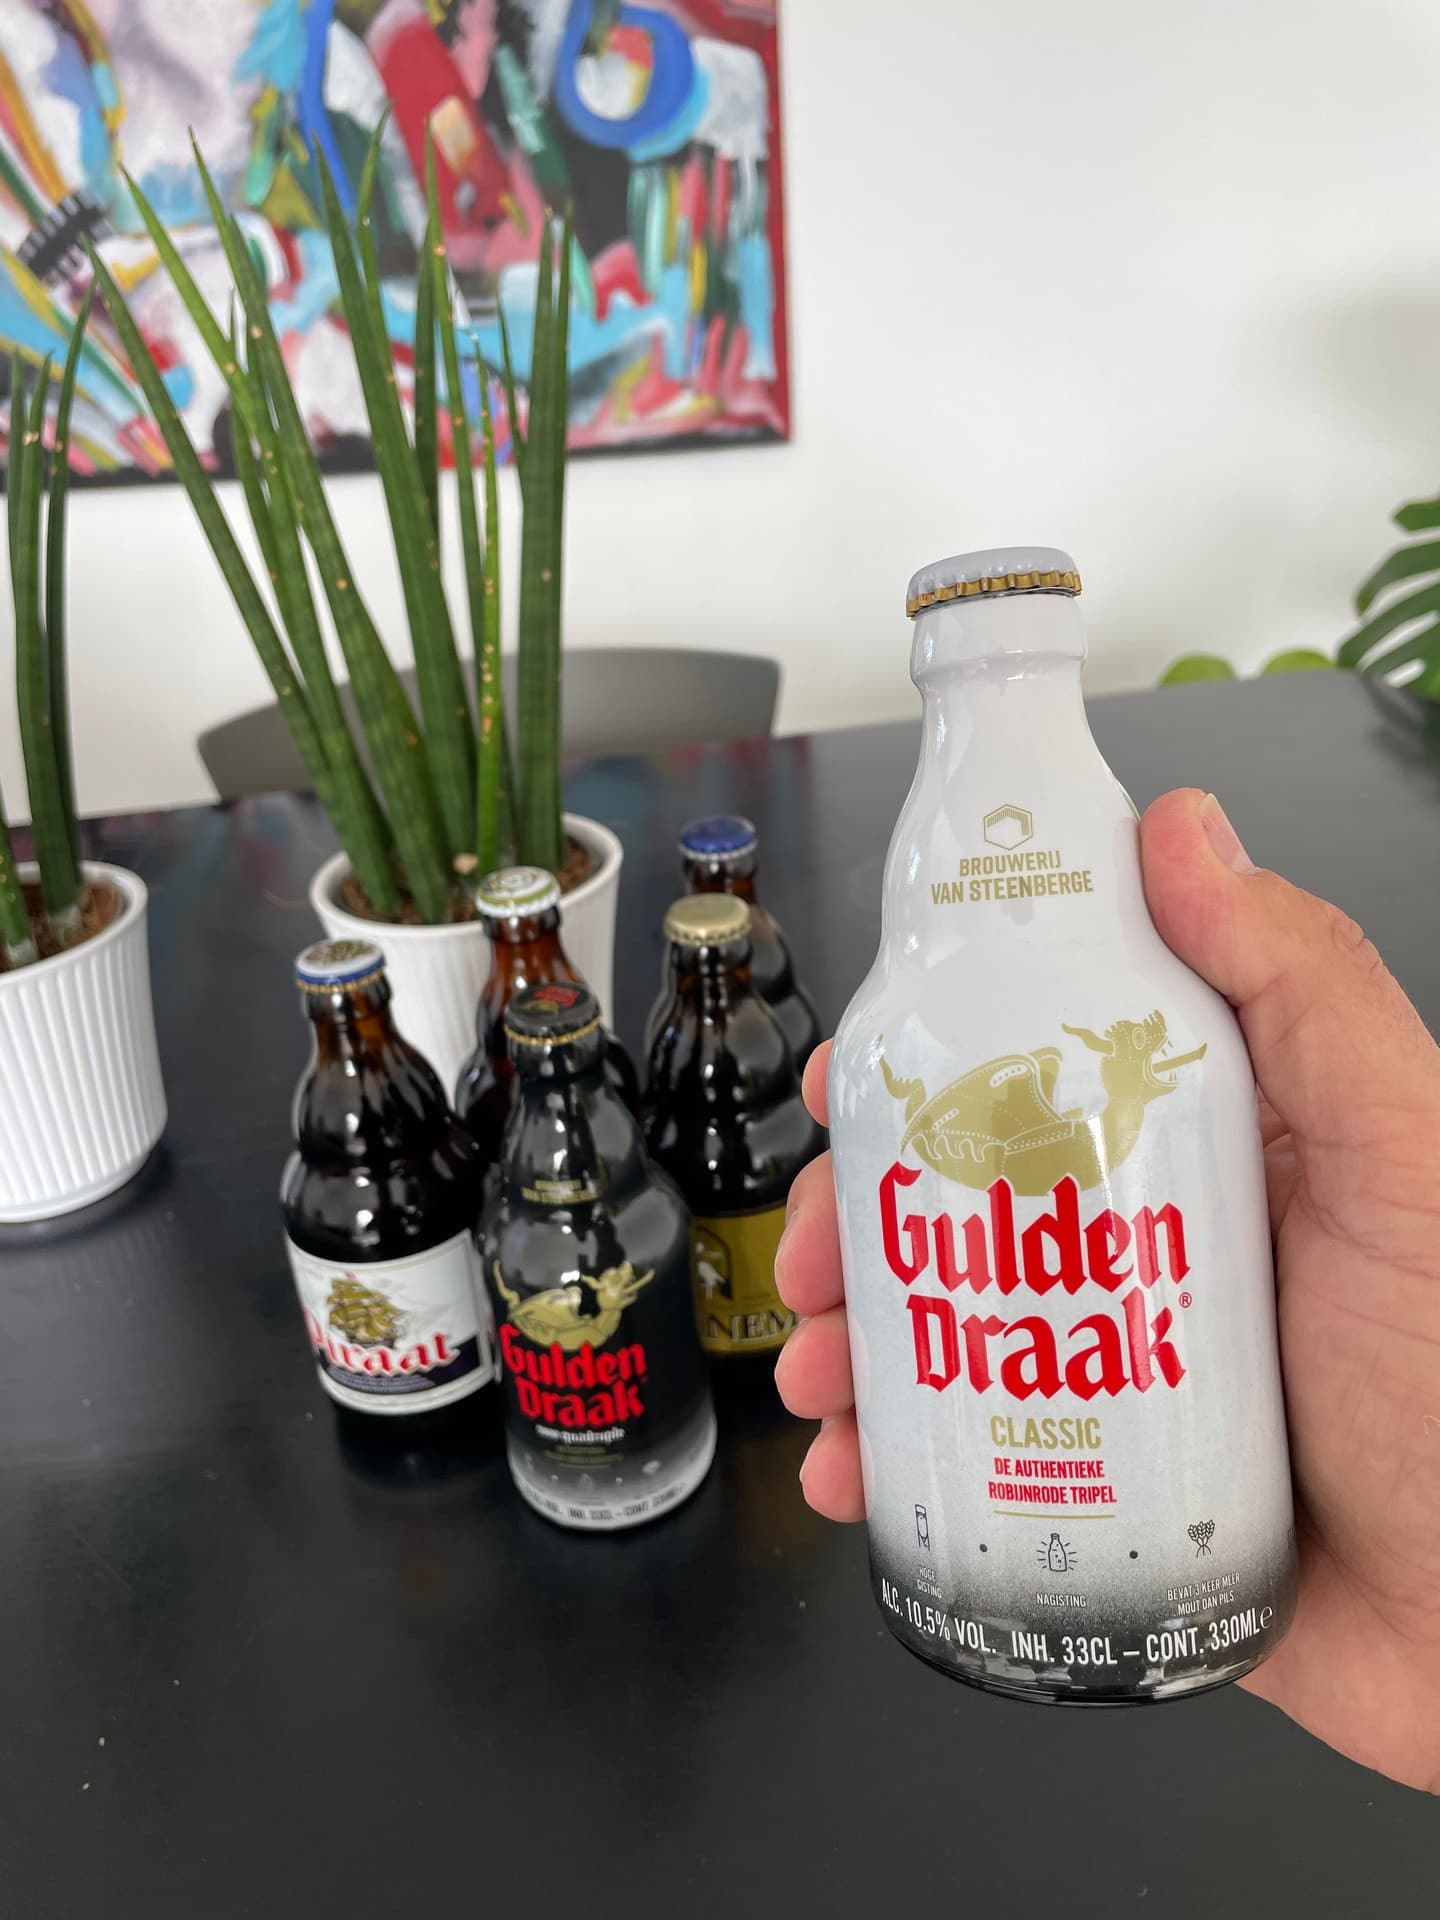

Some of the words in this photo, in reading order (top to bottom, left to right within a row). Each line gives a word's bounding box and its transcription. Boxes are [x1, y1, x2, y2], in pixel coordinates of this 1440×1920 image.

[959, 850, 1061, 877] BROUWERIJ
[931, 881, 964, 905] VAN
[969, 870, 1094, 902] STEENBERGE
[879, 1160, 1191, 1296] Gulden
[500, 1323, 647, 1388] Gulden
[906, 1286, 1187, 1401] Draak
[515, 1377, 645, 1426] Draak
[990, 1415, 1103, 1450] CLASSIC
[994, 1457, 1012, 1476] DE
[1015, 1459, 1105, 1479] AUTHENTIEKE
[988, 1481, 1069, 1505] ROBIJNRODE
[1070, 1485, 1118, 1504] TRIPEL
[1036, 1593, 1087, 1607] NAGISTING
[1167, 1585, 1193, 1601] BEVAT
[1195, 1583, 1201, 1596] 3
[1201, 1578, 1220, 1594] KEER
[1222, 1571, 1240, 1588] MEER
[1177, 1600, 1200, 1616] MOUT
[1202, 1595, 1218, 1610] DAN
[1219, 1589, 1235, 1605] PILS
[882, 1577, 903, 1616] ALC.
[906, 1596, 951, 1641] 10.5%
[954, 1617, 997, 1654] VOL.
[1011, 1630, 1055, 1662] INH.
[1062, 1636, 1118, 1665] 33CL
[1146, 1626, 1204, 1663] CONT.
